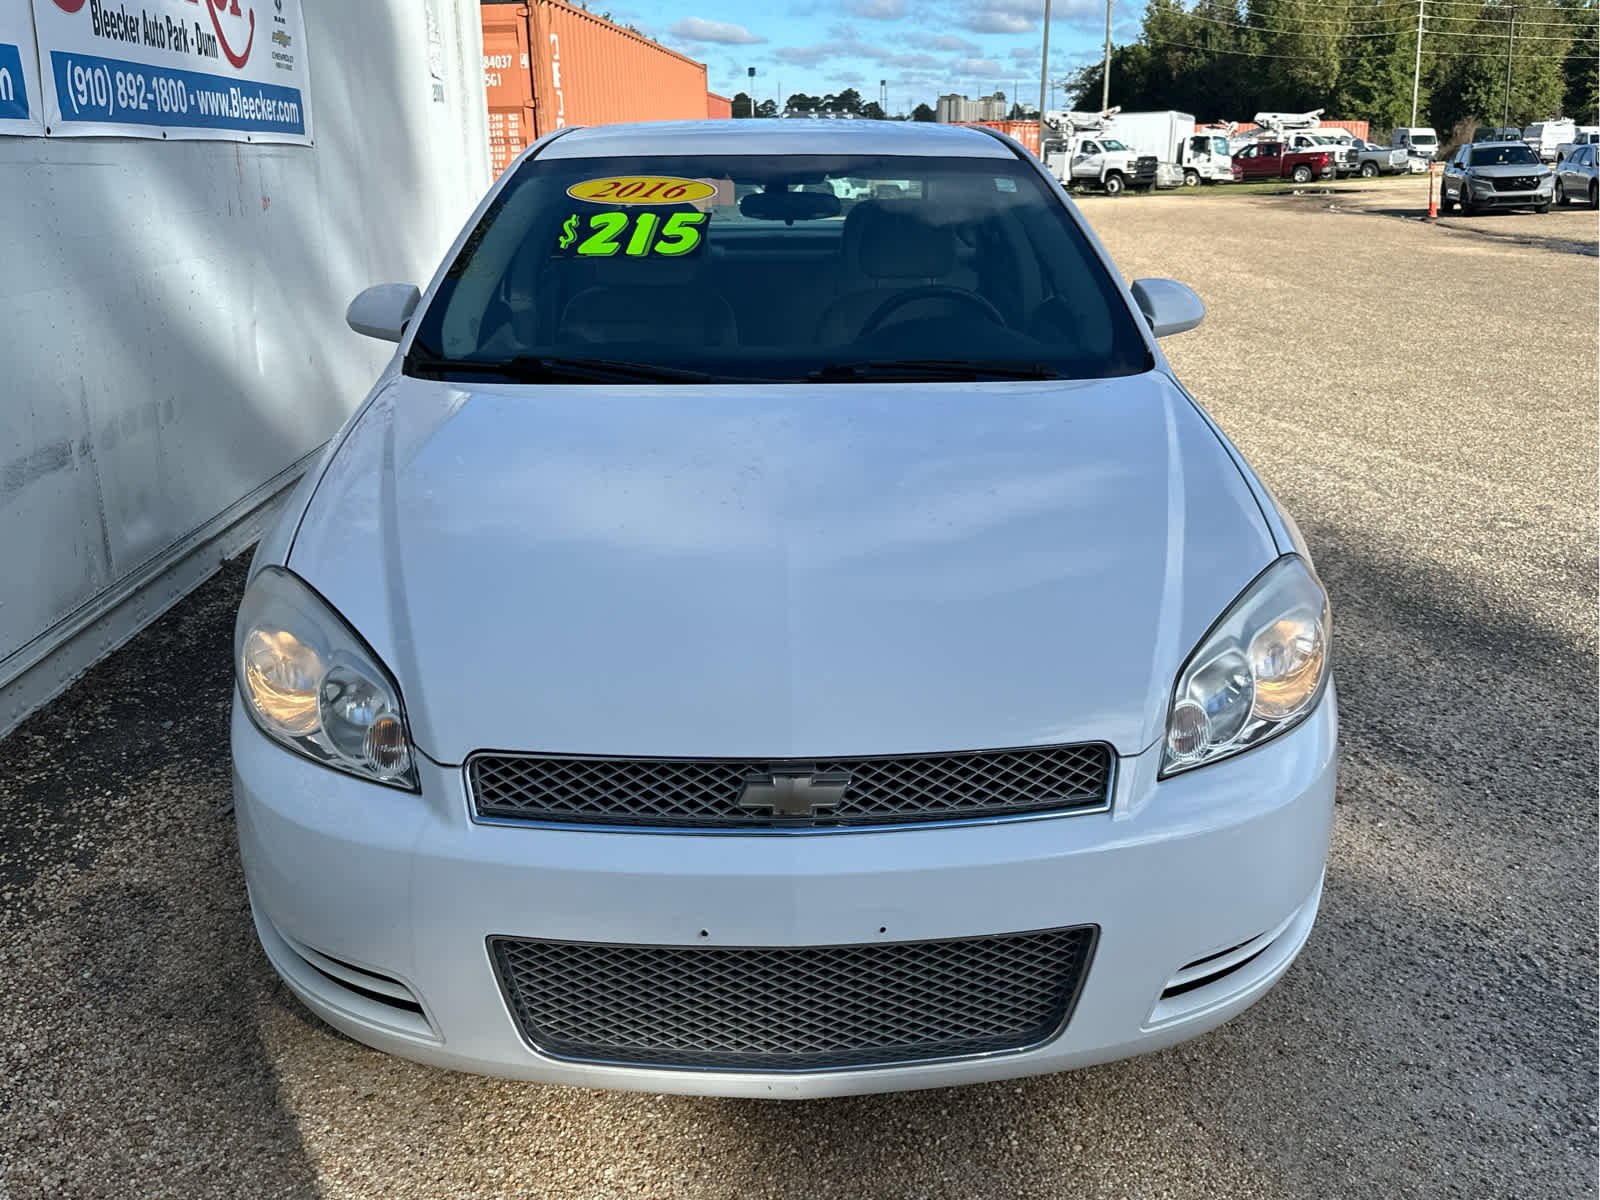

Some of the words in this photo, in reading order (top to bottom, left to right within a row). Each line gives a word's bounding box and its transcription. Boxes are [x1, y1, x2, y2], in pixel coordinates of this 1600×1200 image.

[89, 0, 140, 44] Bleecker
[142, 8, 166, 49] Auto
[165, 15, 190, 54] Park
[194, 21, 219, 59] Dunn
[67, 60, 113, 116] (910)
[115, 71, 188, 113] 892-1800
[196, 87, 300, 124] www.Bleecker.com
[589, 181, 695, 199] 2016
[559, 212, 706, 256] $215
